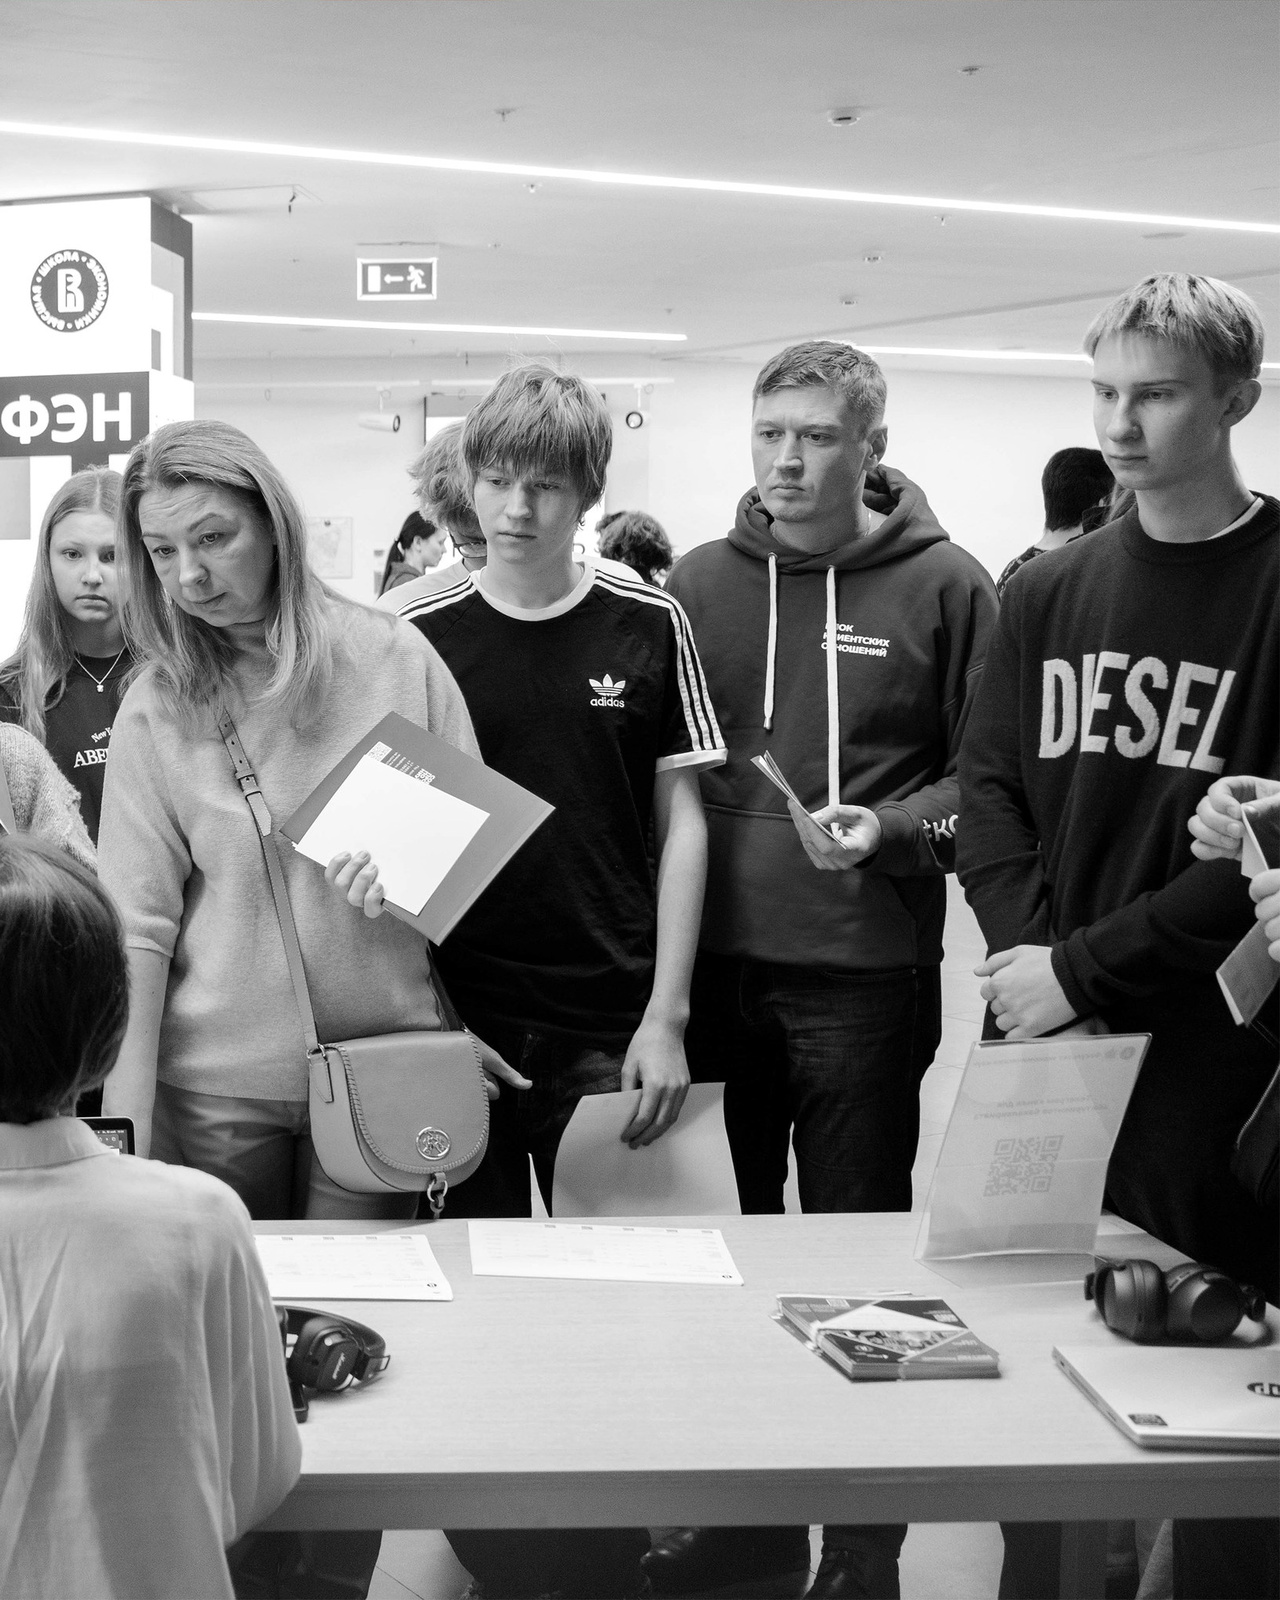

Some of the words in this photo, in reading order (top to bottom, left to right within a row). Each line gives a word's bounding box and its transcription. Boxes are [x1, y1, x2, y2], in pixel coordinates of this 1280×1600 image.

[38, 251, 80, 277] ШКОЛА
[1, 392, 131, 444] ФЭН
[823, 632, 890, 647] КИЕНТСКИХ
[821, 642, 887, 657] ОНОШЕНИЙ
[590, 696, 625, 708] adidas
[1039, 651, 1236, 774] DIESEL
[91, 732, 107, 743] New
[73, 748, 109, 768] ABE
